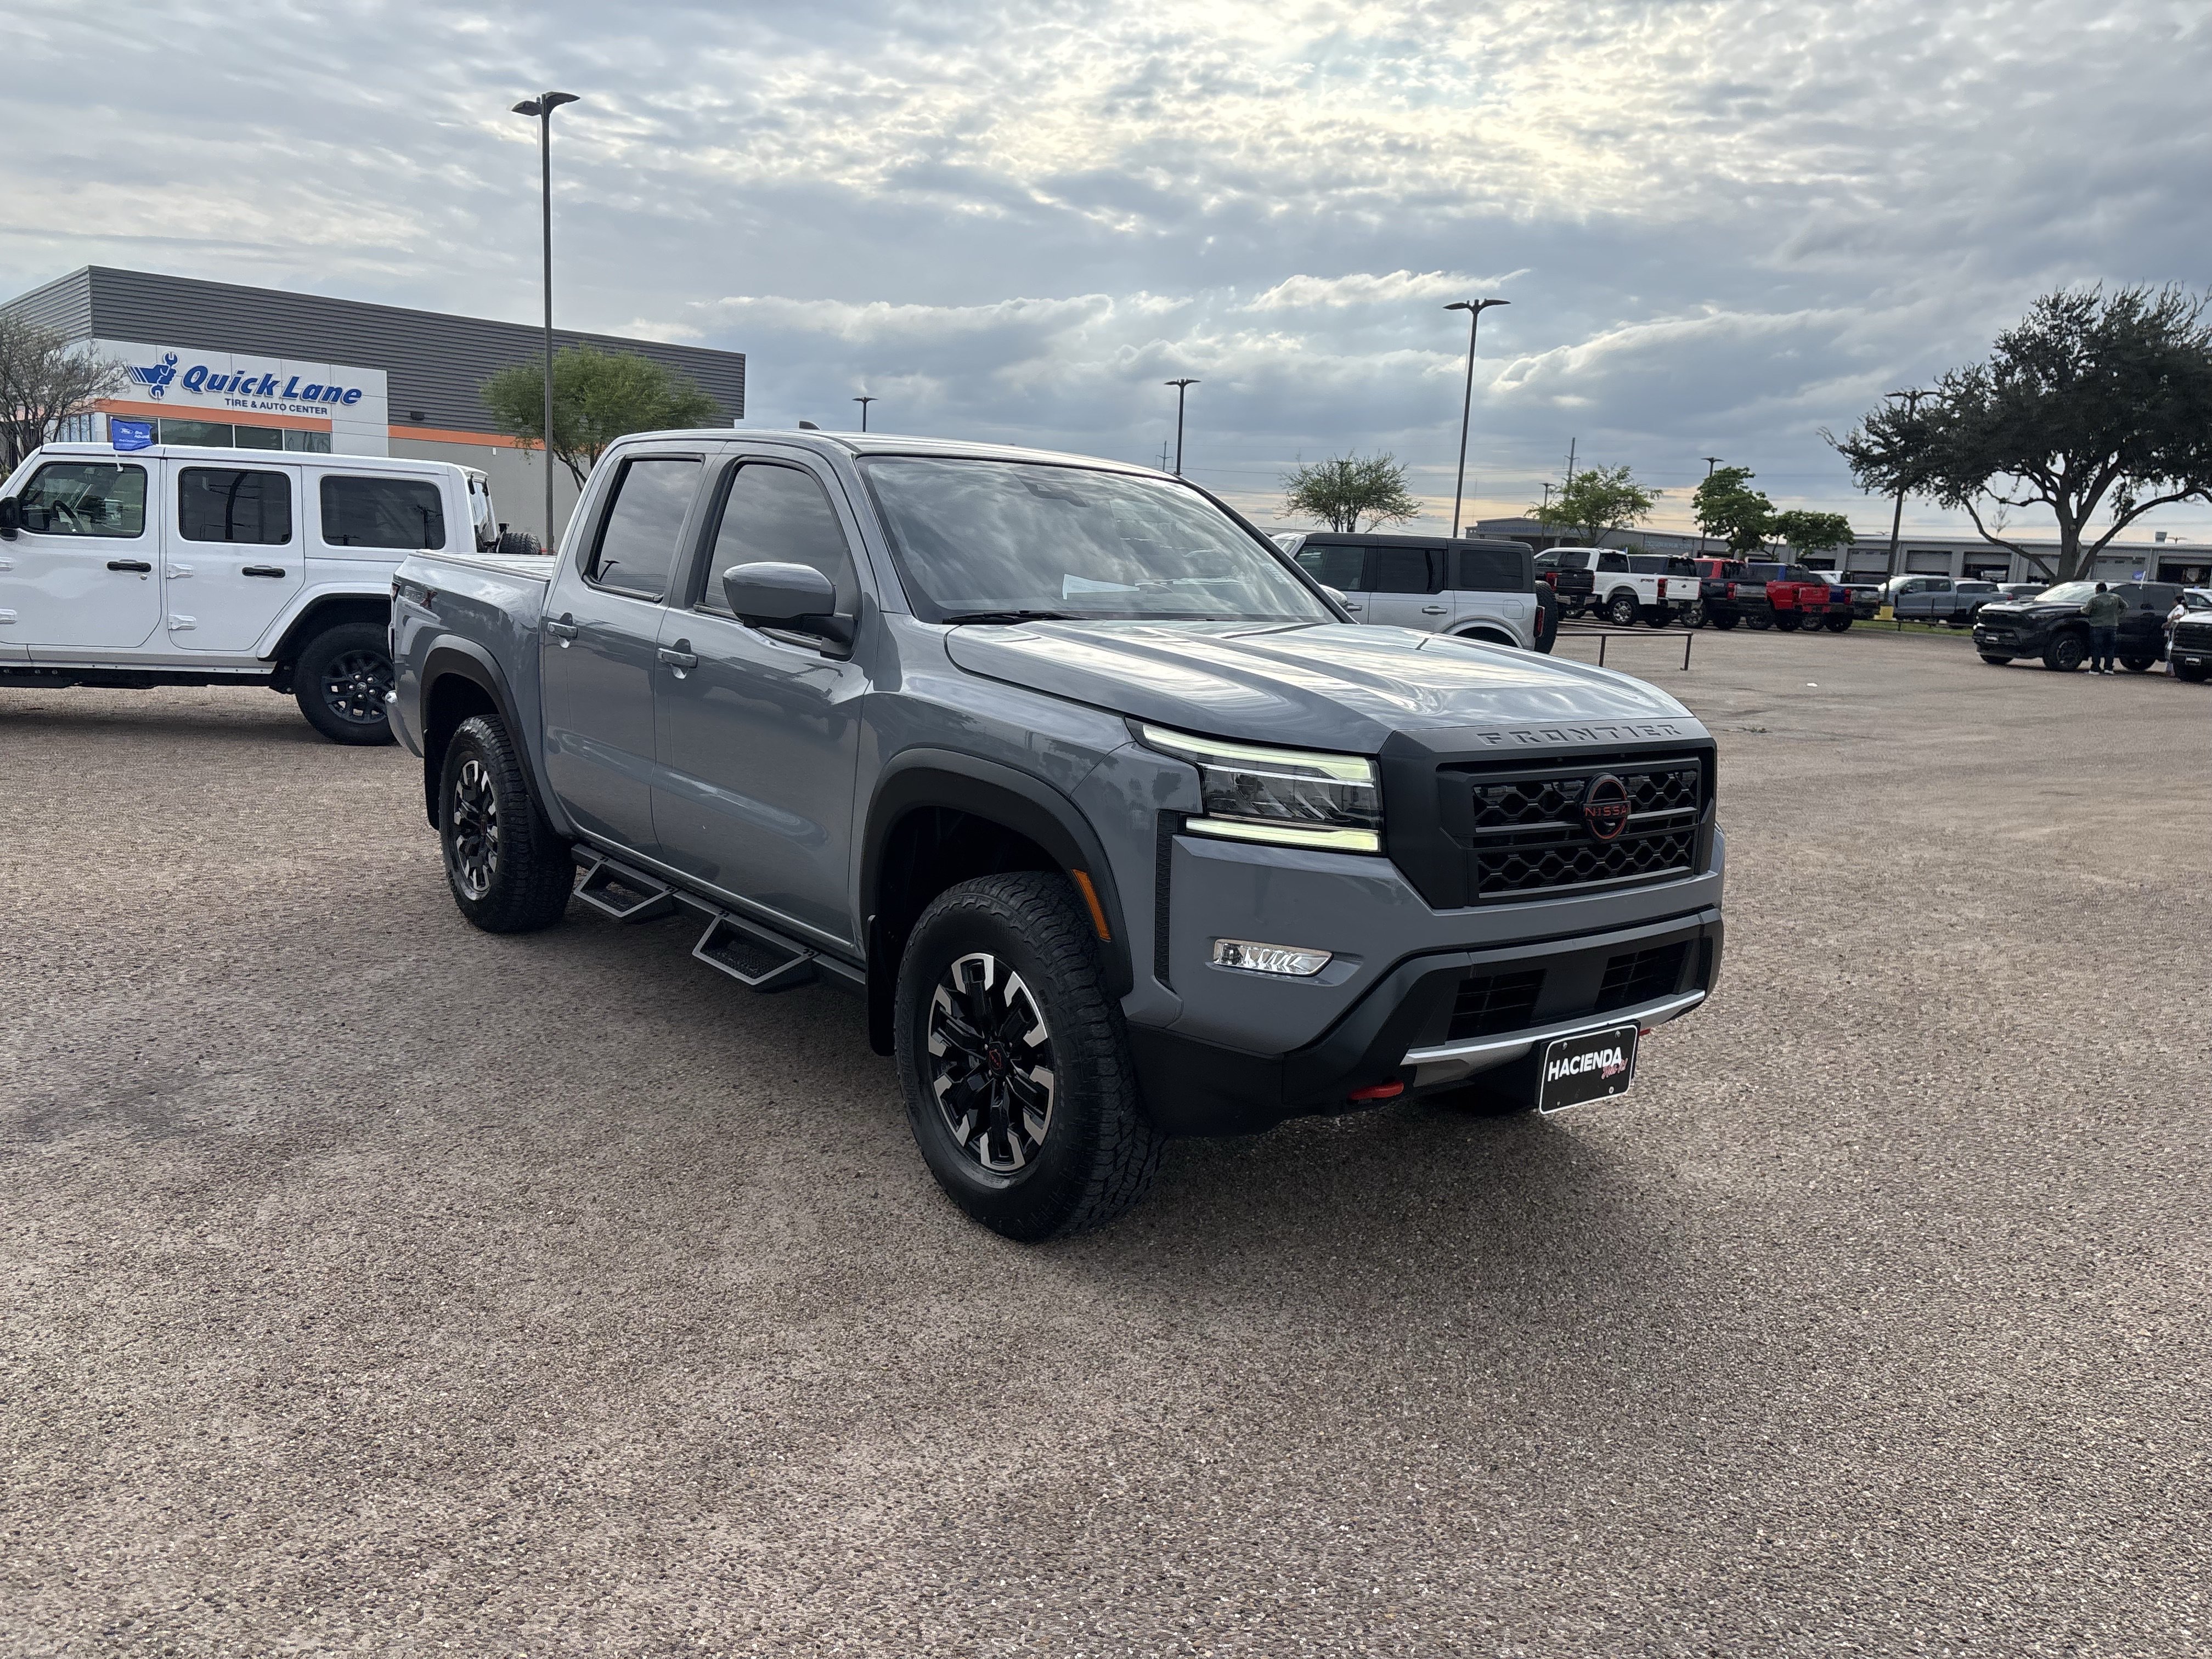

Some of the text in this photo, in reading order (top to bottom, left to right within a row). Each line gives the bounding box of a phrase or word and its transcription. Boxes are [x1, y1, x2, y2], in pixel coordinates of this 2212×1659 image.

[182, 364, 363, 405] Quick Lane
[224, 398, 249, 408] TIRE
[259, 402, 287, 411] AUTO
[289, 404, 328, 415] CENTER
[1475, 724, 1683, 746] FRONTIER
[1547, 1047, 1622, 1082] HACIENDA
